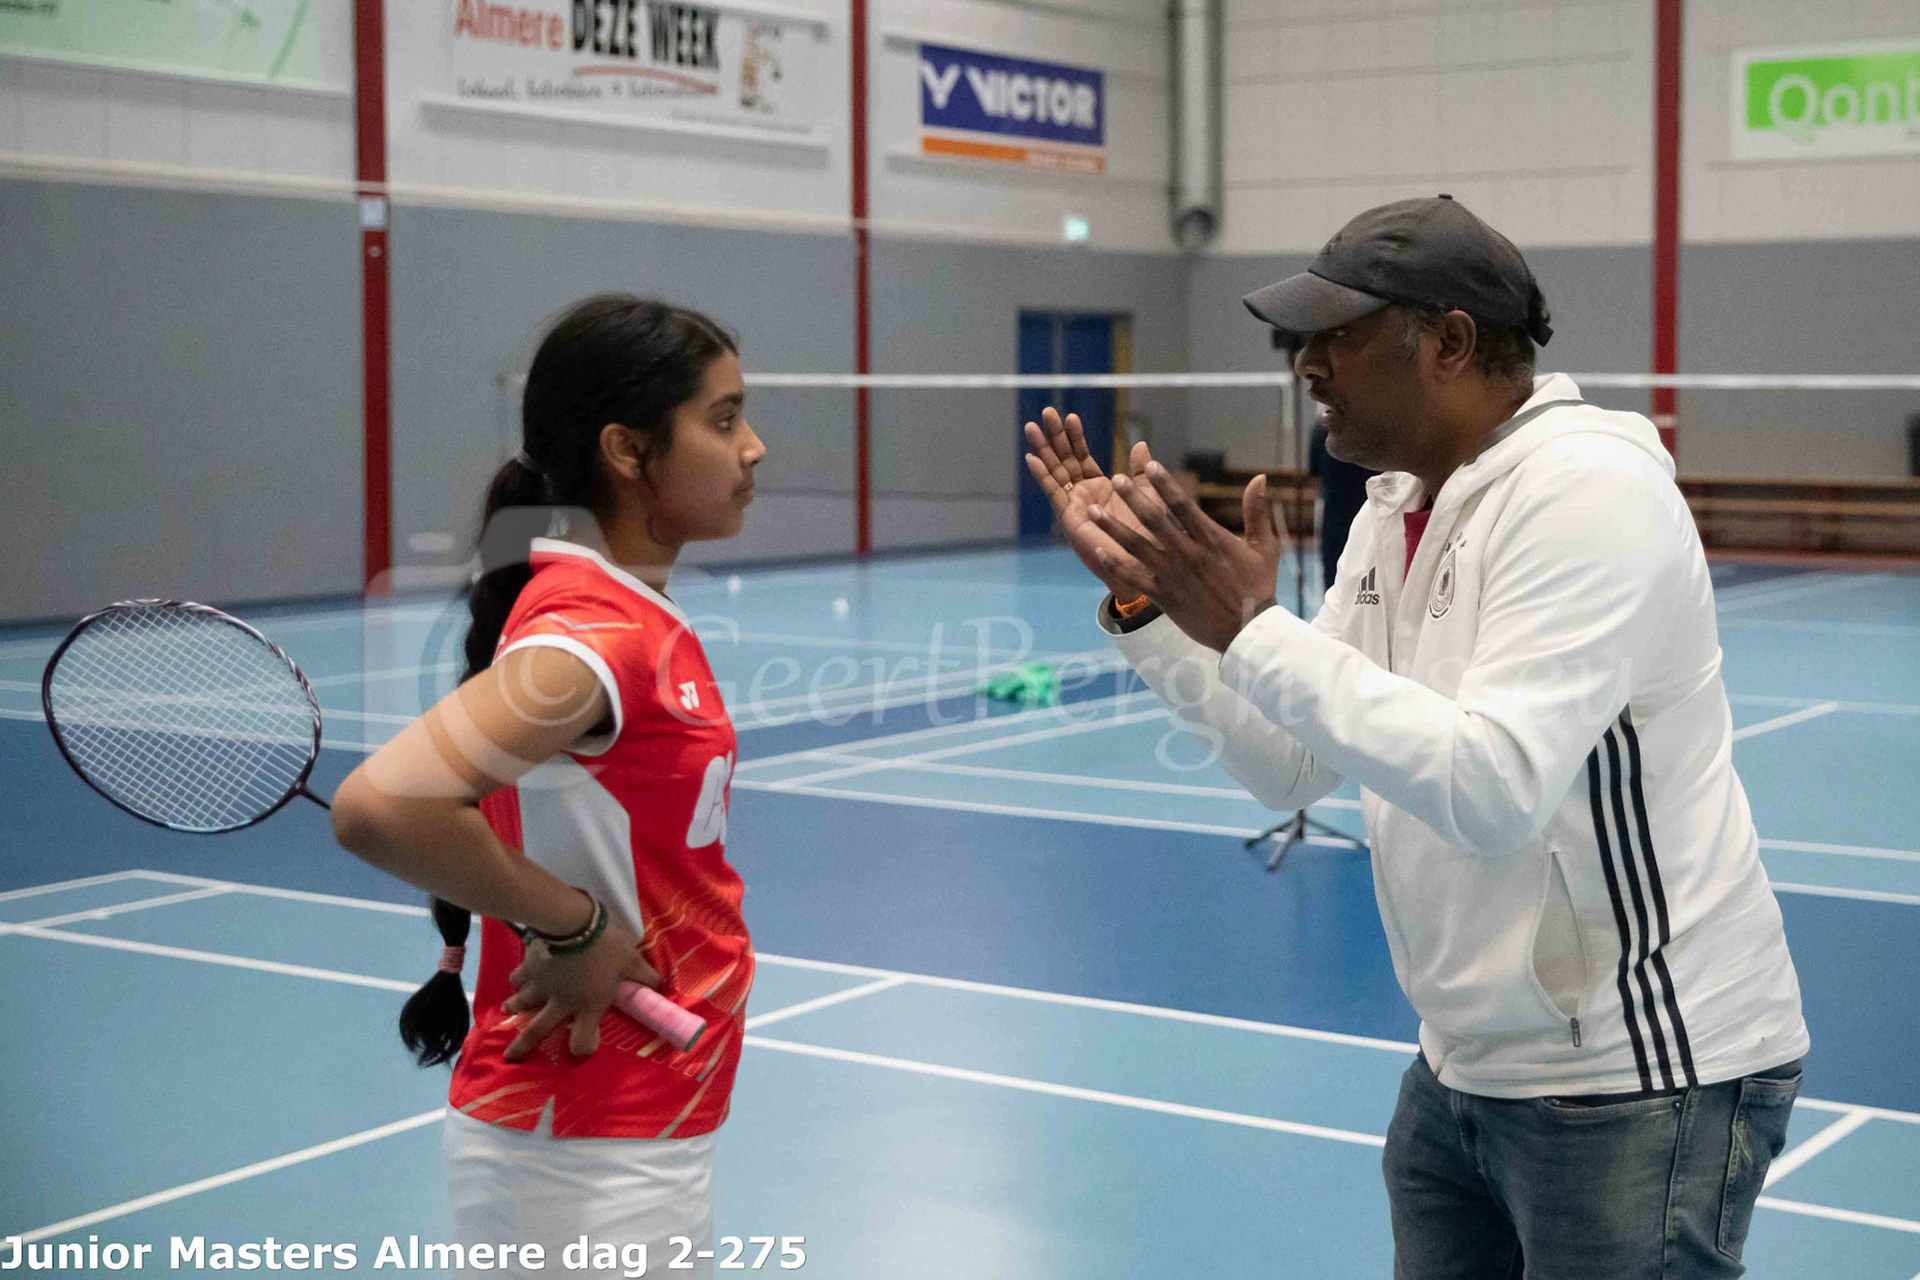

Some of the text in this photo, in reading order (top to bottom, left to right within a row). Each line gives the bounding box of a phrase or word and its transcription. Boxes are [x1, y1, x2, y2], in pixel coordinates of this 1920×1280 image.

[571, 0, 641, 59] DEZE
[647, 2, 720, 70] WEEK
[964, 64, 1099, 131] VICTOR
